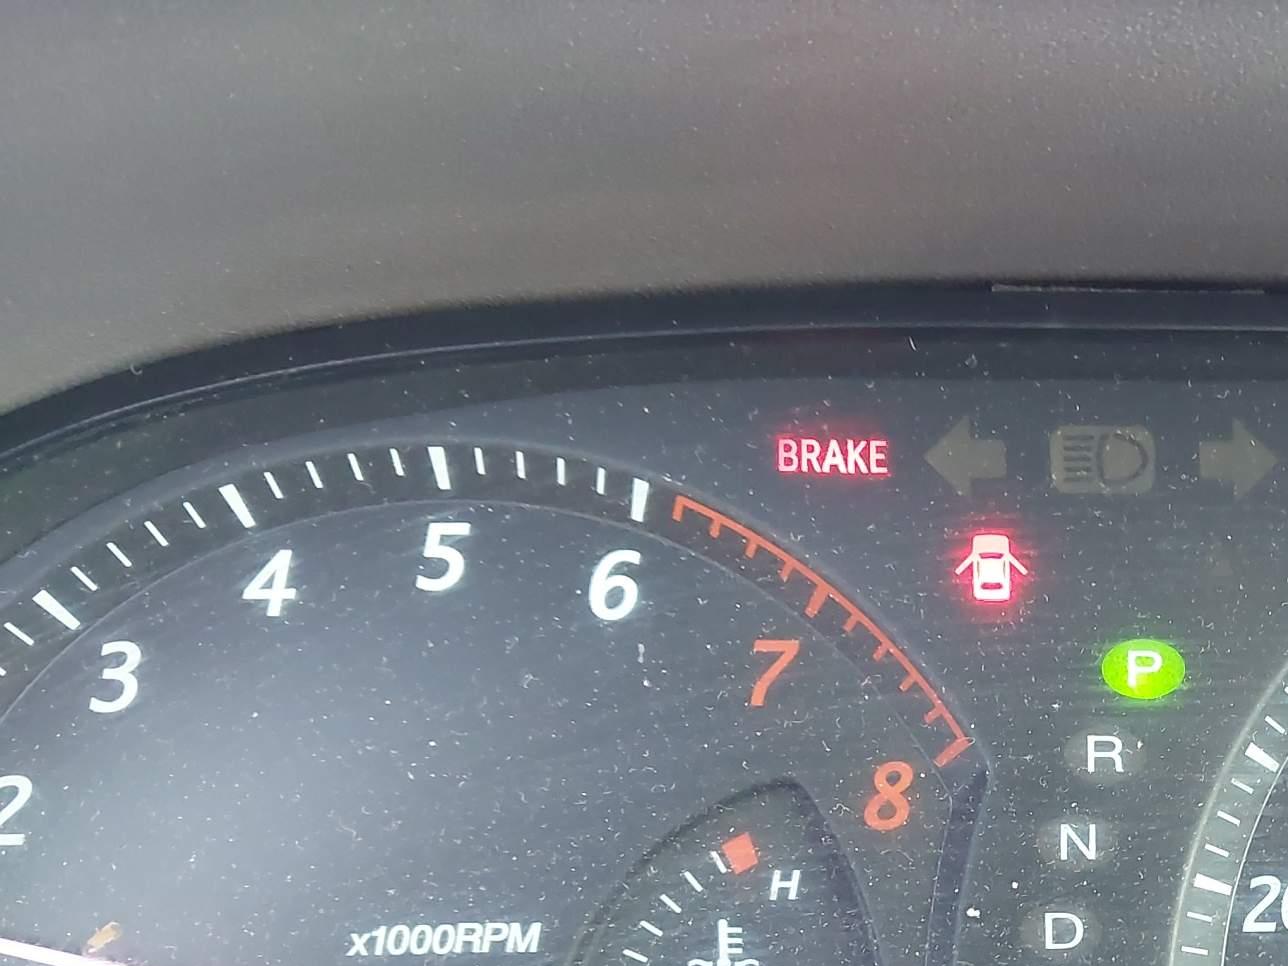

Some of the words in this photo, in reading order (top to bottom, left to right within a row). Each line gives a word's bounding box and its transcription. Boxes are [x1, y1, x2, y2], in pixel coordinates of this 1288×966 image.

[777, 439, 889, 475] BRAKE
[415, 522, 471, 592] 5
[242, 549, 296, 616] 4
[588, 549, 641, 621] 6
[89, 641, 142, 713] 3
[750, 639, 800, 707] 7
[1126, 649, 1163, 688] P
[1086, 735, 1124, 773] R
[864, 760, 913, 831] 8
[1059, 823, 1096, 860] N
[769, 870, 801, 901] H
[345, 922, 541, 958] x1000RPM
[1044, 912, 1083, 950] D
